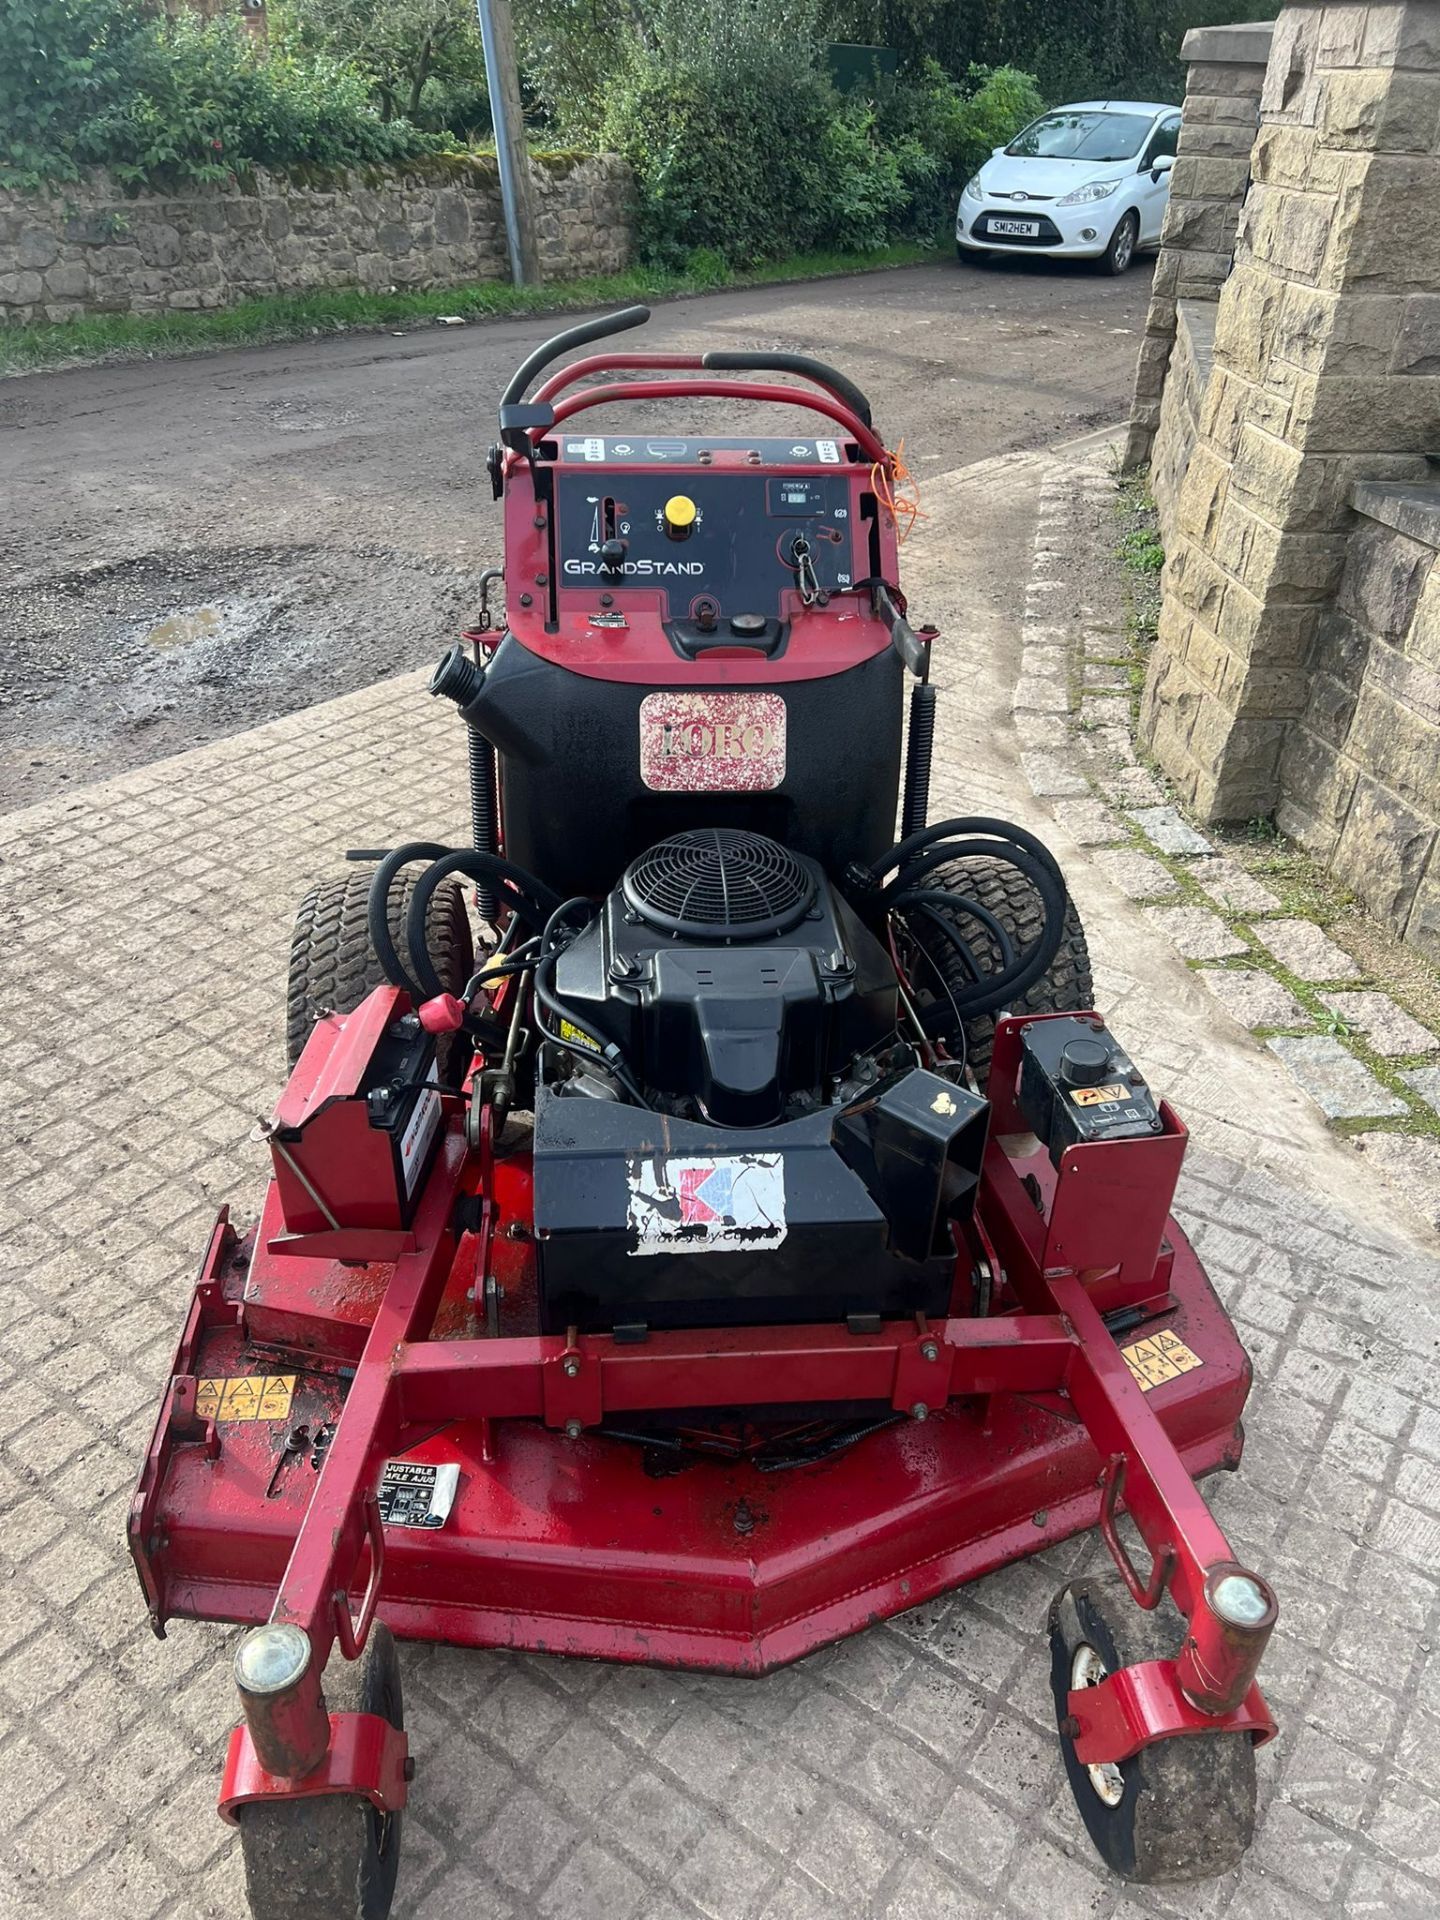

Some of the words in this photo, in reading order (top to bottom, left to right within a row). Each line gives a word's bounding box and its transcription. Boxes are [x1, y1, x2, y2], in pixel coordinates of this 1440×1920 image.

[993, 221, 1032, 234] SM12HEM
[386, 1464, 433, 1475] JUSTABLE
[383, 1472, 409, 1481] AFLE
